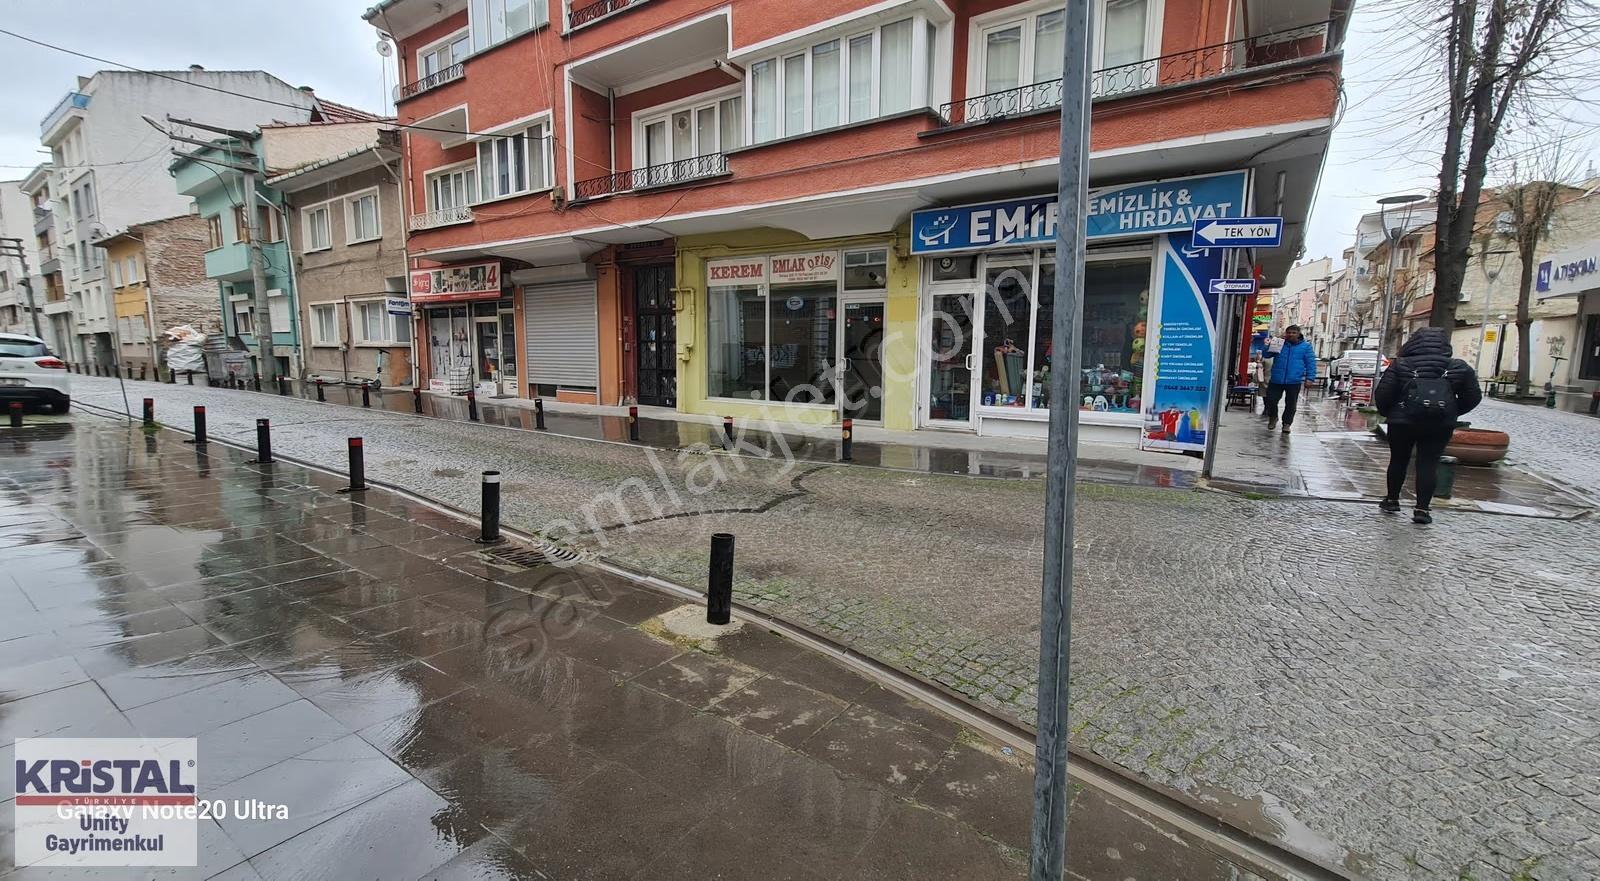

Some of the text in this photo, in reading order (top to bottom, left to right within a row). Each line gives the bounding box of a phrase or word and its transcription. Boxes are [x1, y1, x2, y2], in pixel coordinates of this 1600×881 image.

[1087, 188, 1192, 216] EMİZLİK &
[1119, 202, 1232, 230] HIRDAVAT
[1224, 225, 1271, 237] TEK YÖN
[710, 263, 763, 280] KEREM
[772, 258, 806, 274] EMLAK
[486, 265, 497, 287] 4
